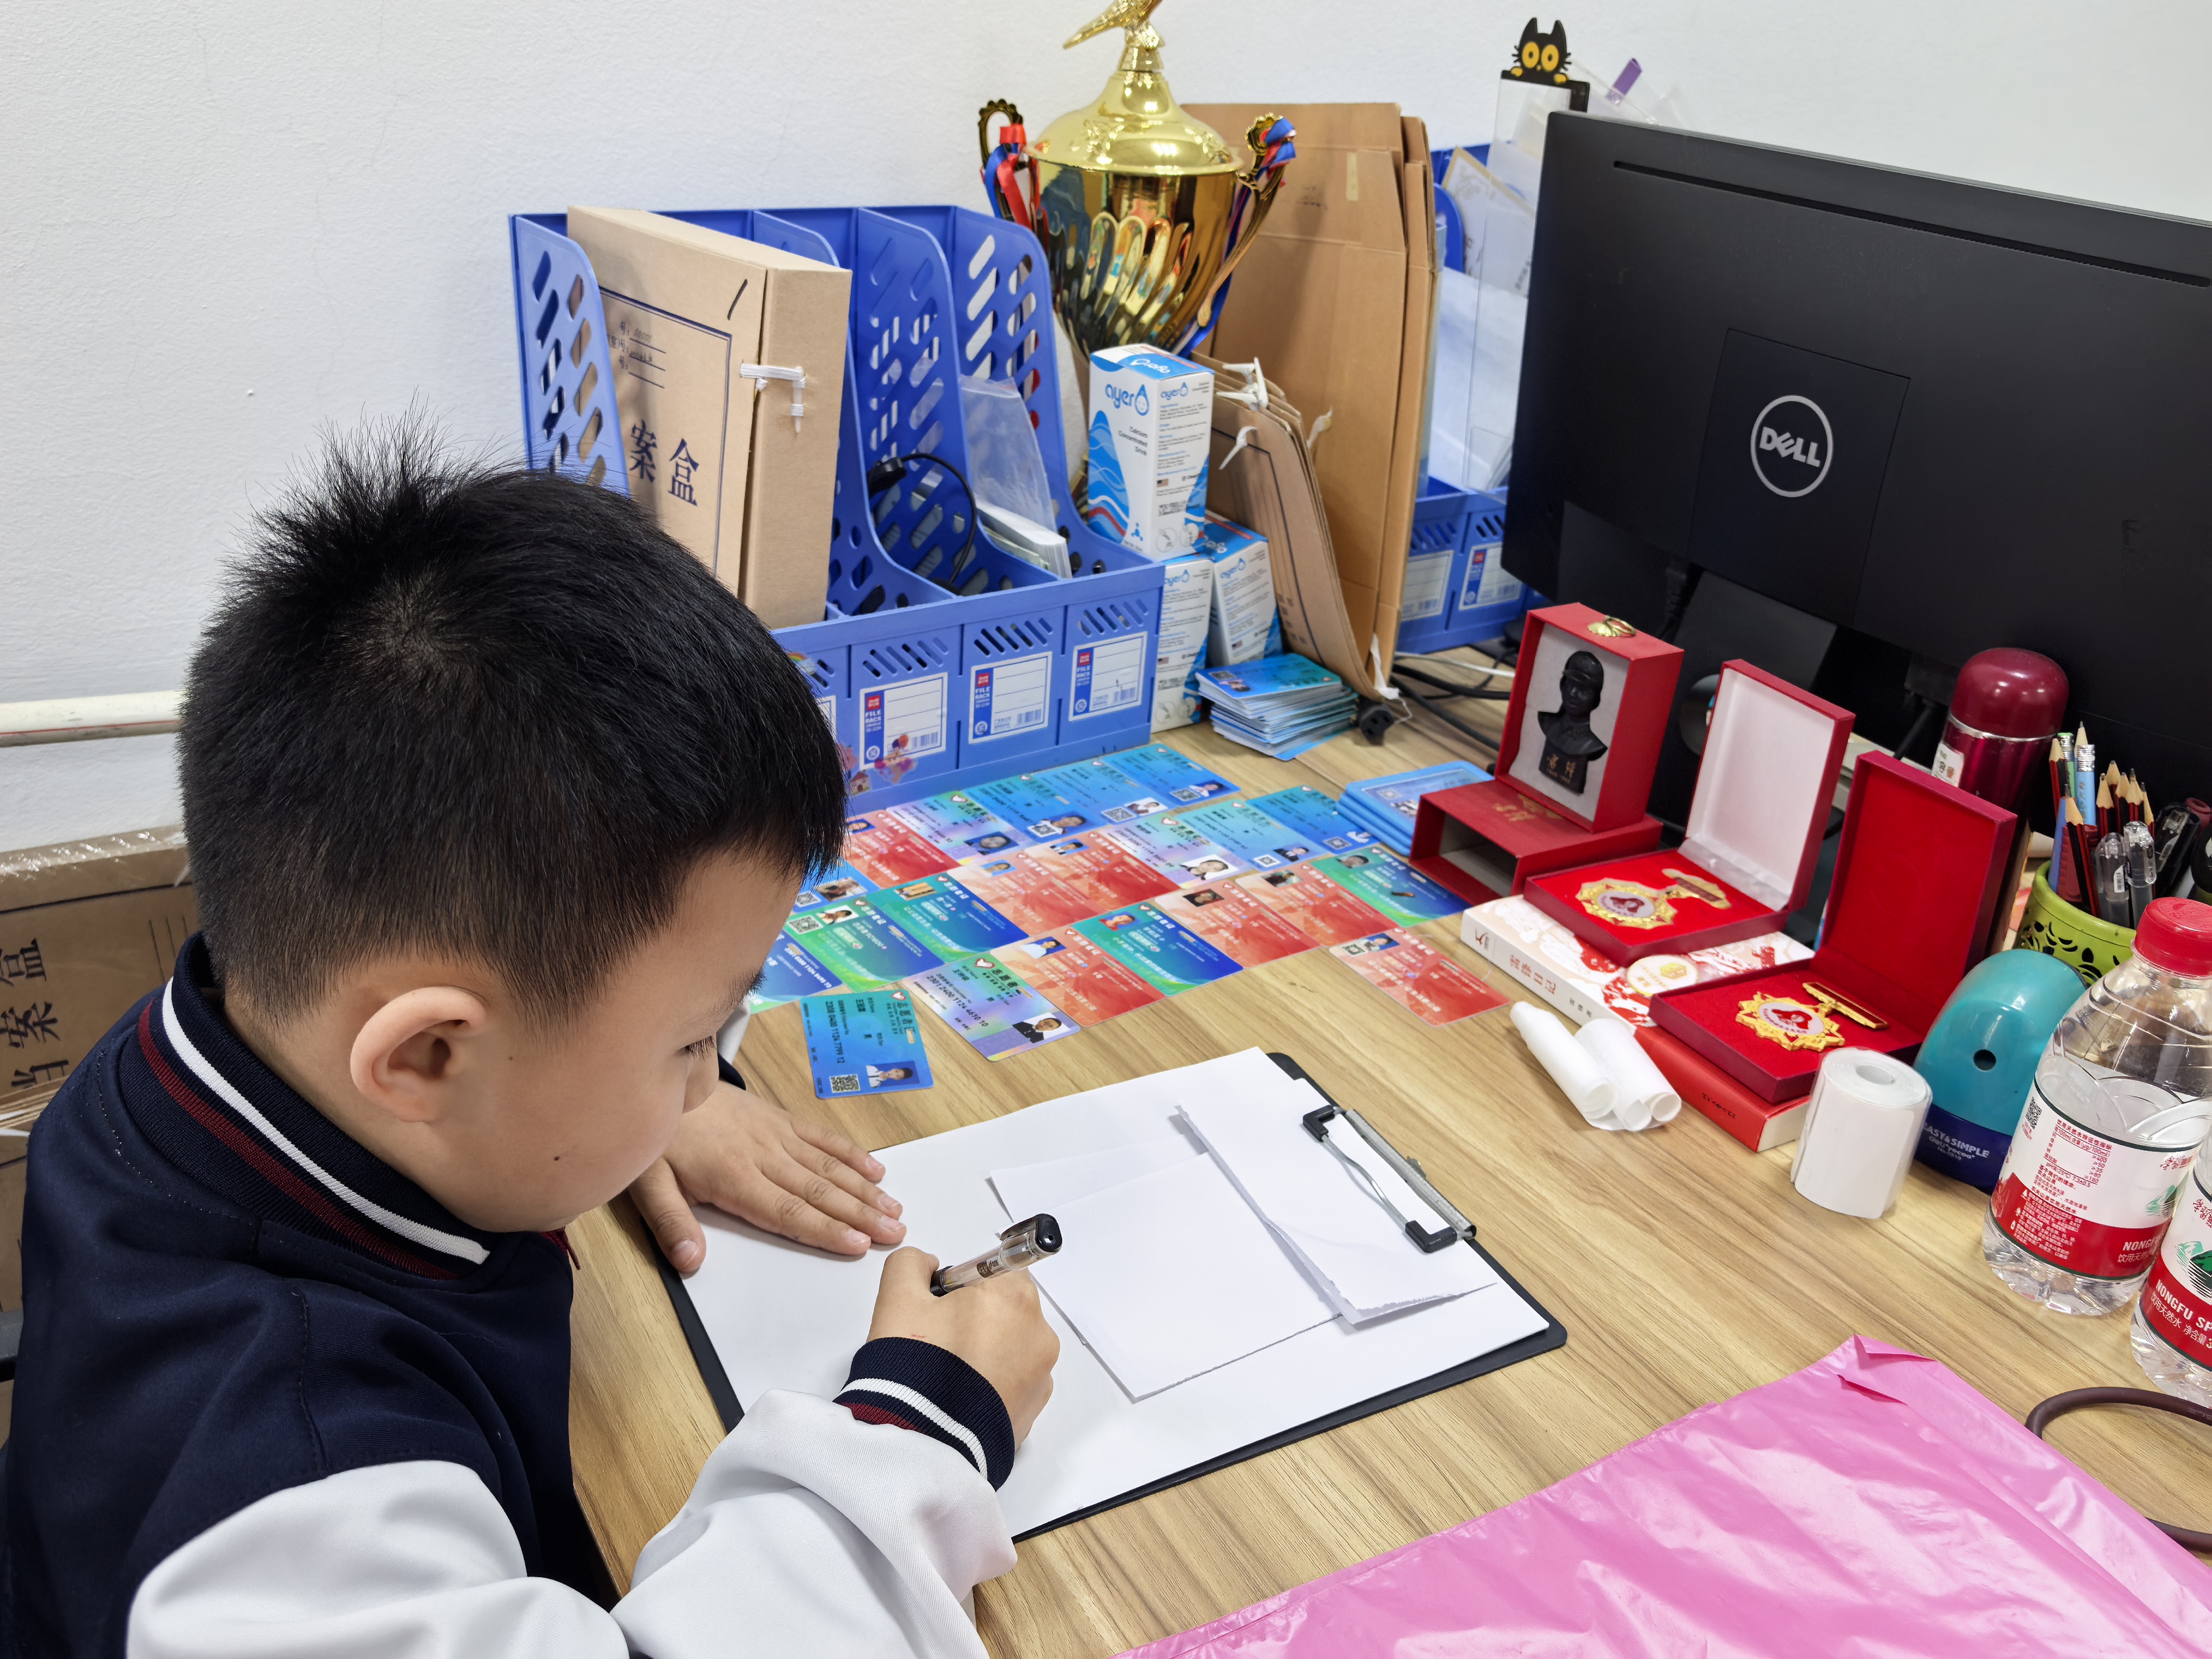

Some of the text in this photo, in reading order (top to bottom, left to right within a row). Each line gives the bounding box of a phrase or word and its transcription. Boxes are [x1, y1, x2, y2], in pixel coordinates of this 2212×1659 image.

[629, 419, 700, 507] 案盒
[1759, 426, 1820, 468] DELL
[2150, 1291, 2182, 1328] 饮用天然水
[2183, 1324, 2207, 1346] 净含量
[2155, 1279, 2194, 1320] NONGFU
